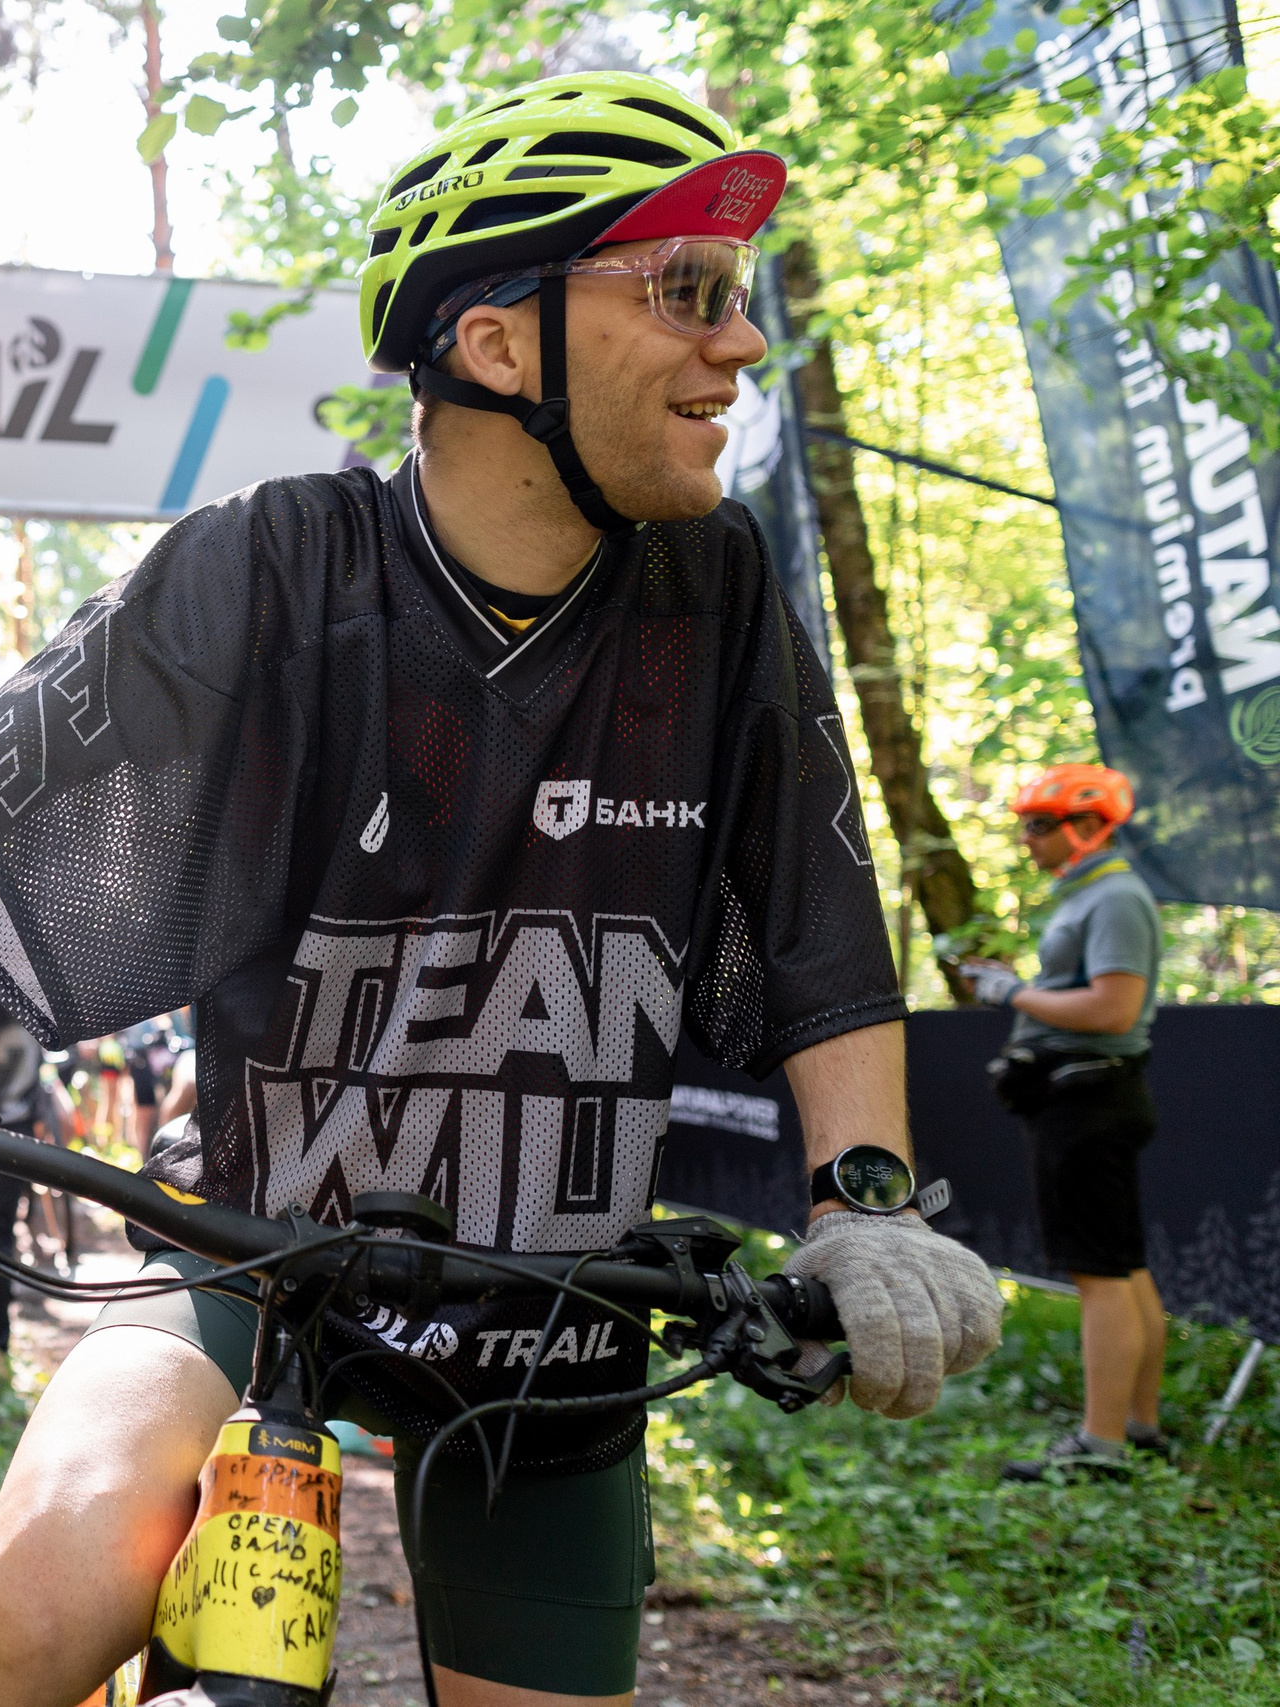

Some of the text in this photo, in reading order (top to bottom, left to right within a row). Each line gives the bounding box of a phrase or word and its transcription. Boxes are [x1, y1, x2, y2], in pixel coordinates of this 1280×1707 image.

[419, 170, 485, 202] GIRO
[721, 166, 775, 200] COFFEE
[711, 193, 757, 225] PIZZA
[595, 797, 708, 829] БАНК
[865, 1164, 880, 1180] 27
[880, 1165, 894, 1181] 08
[475, 1320, 620, 1368] TRAIL
[273, 1436, 316, 1456] MBM
[228, 1513, 303, 1538] OPEN
